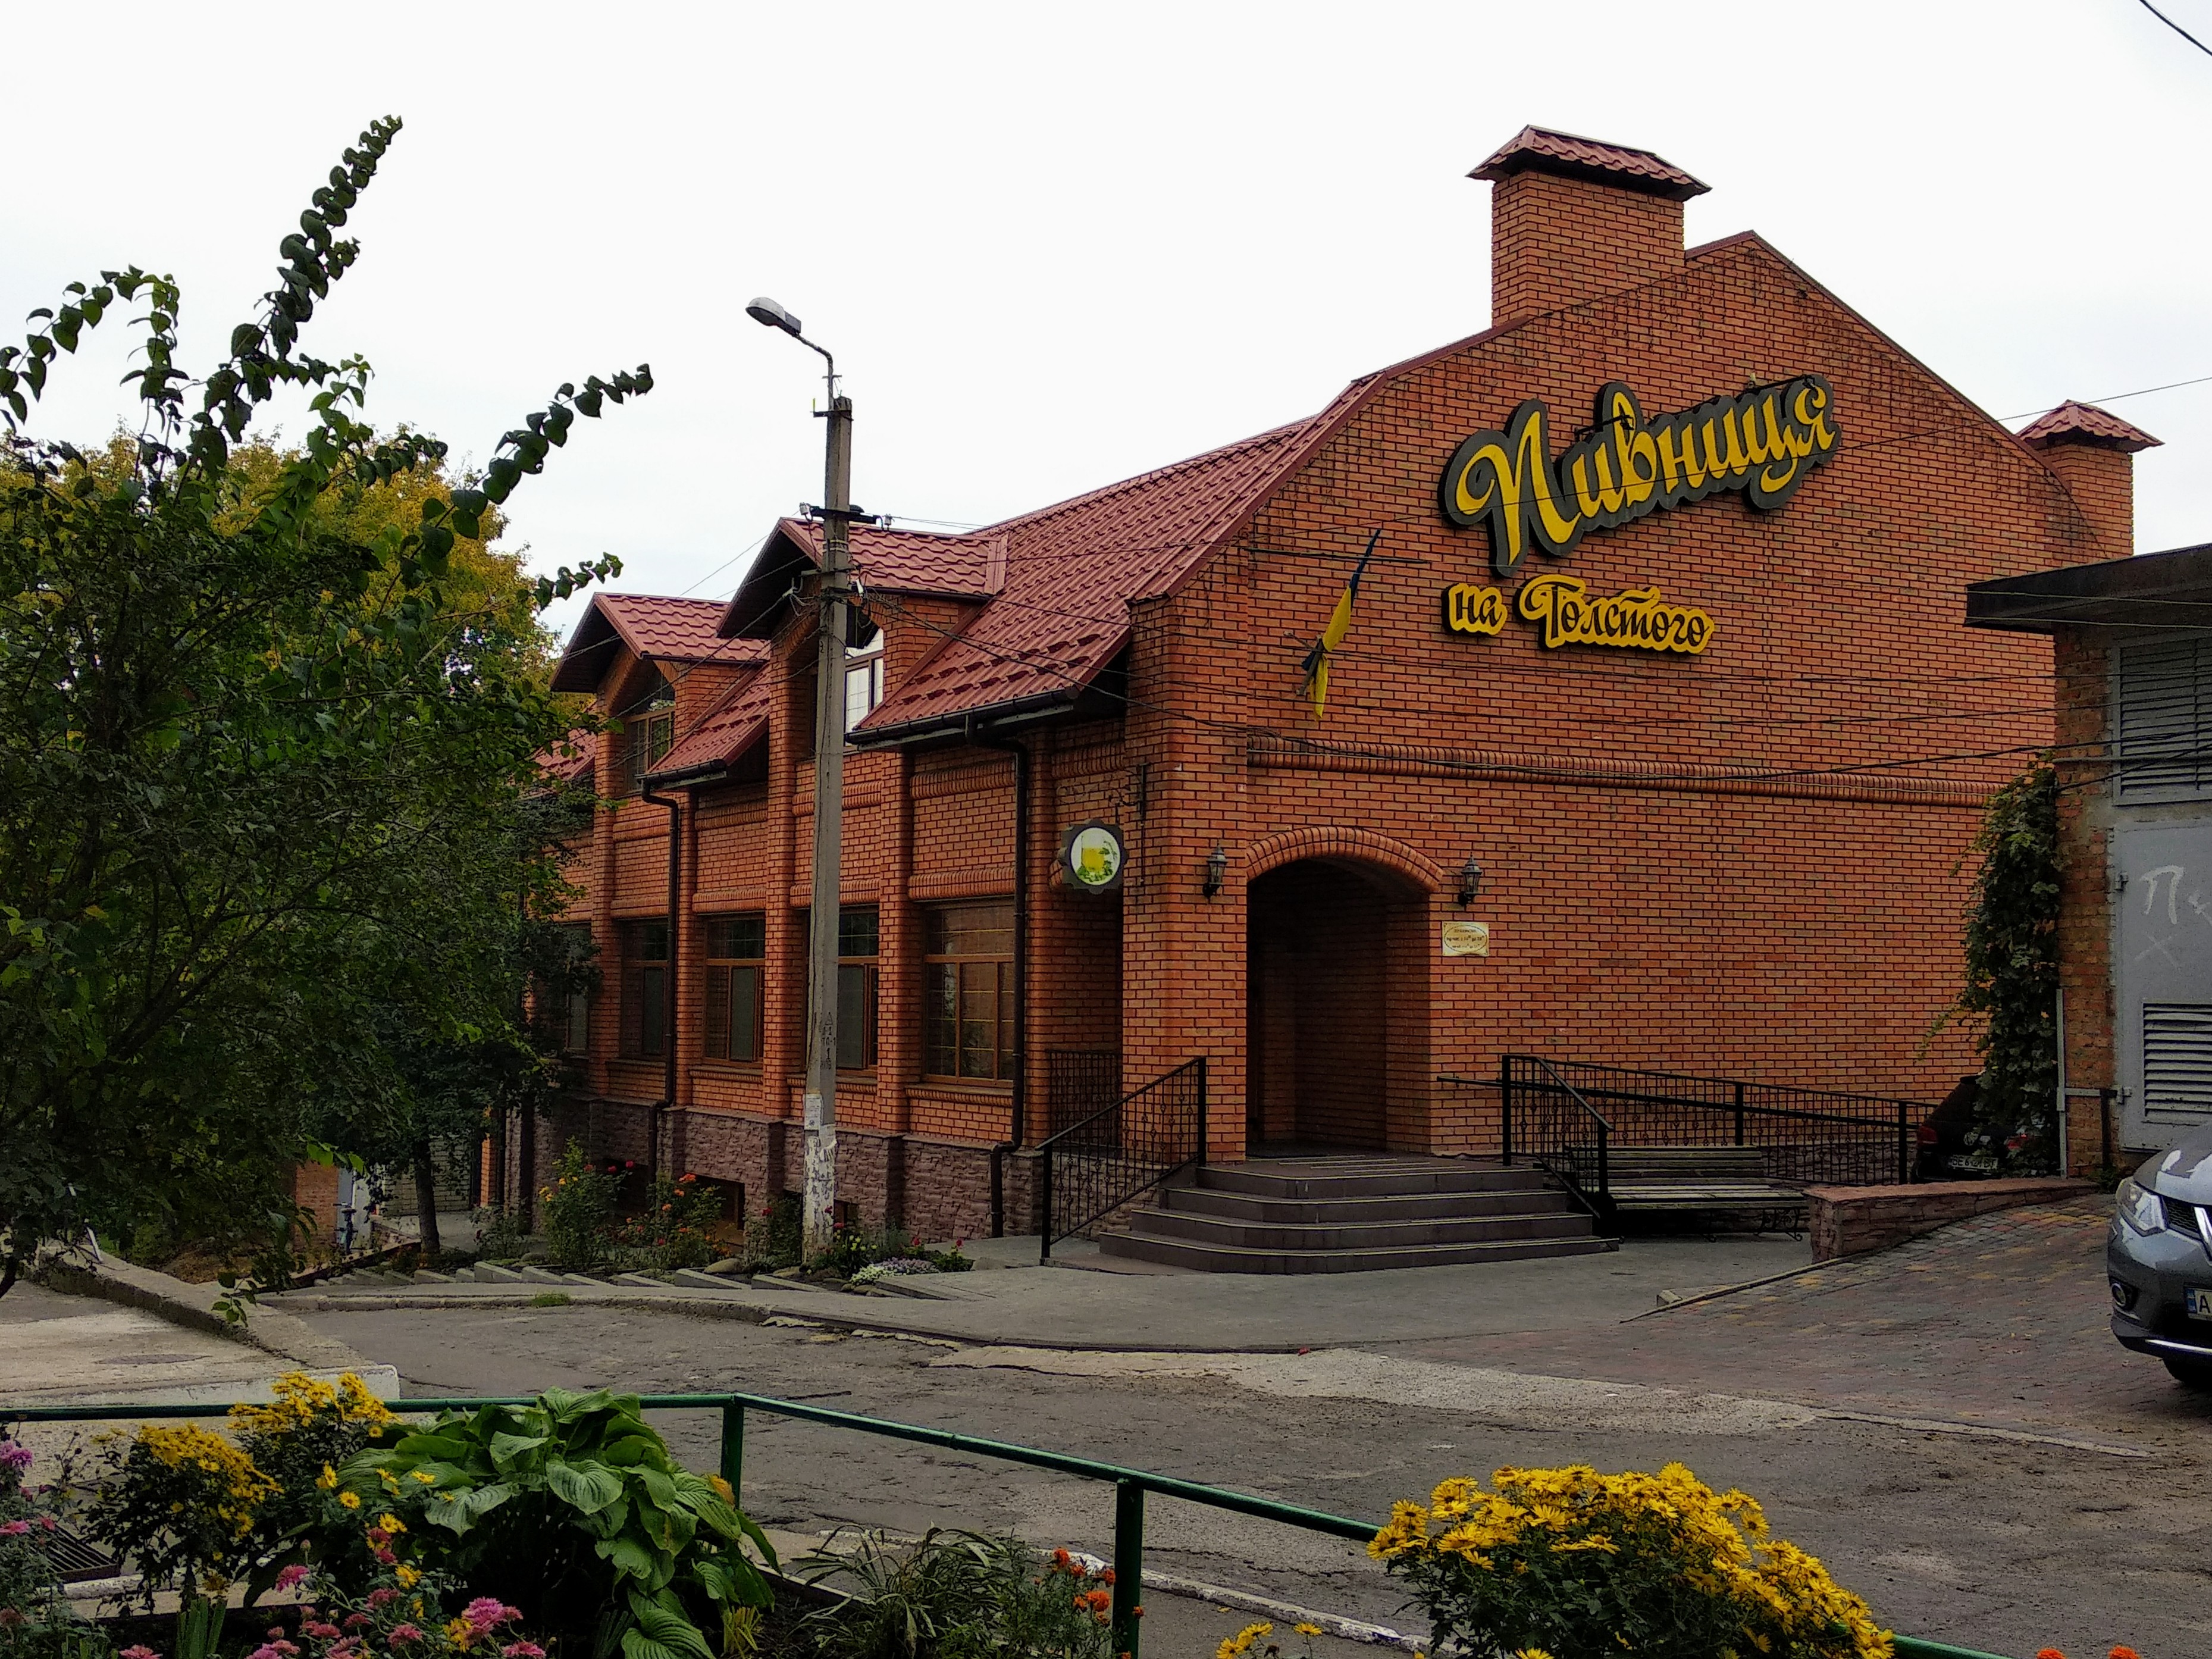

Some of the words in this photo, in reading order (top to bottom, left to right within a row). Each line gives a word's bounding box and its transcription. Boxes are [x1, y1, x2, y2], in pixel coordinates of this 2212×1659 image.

[1456, 386, 1835, 566] Пивниця
[1455, 590, 1502, 627] на
[1524, 580, 1710, 647] Толстого
